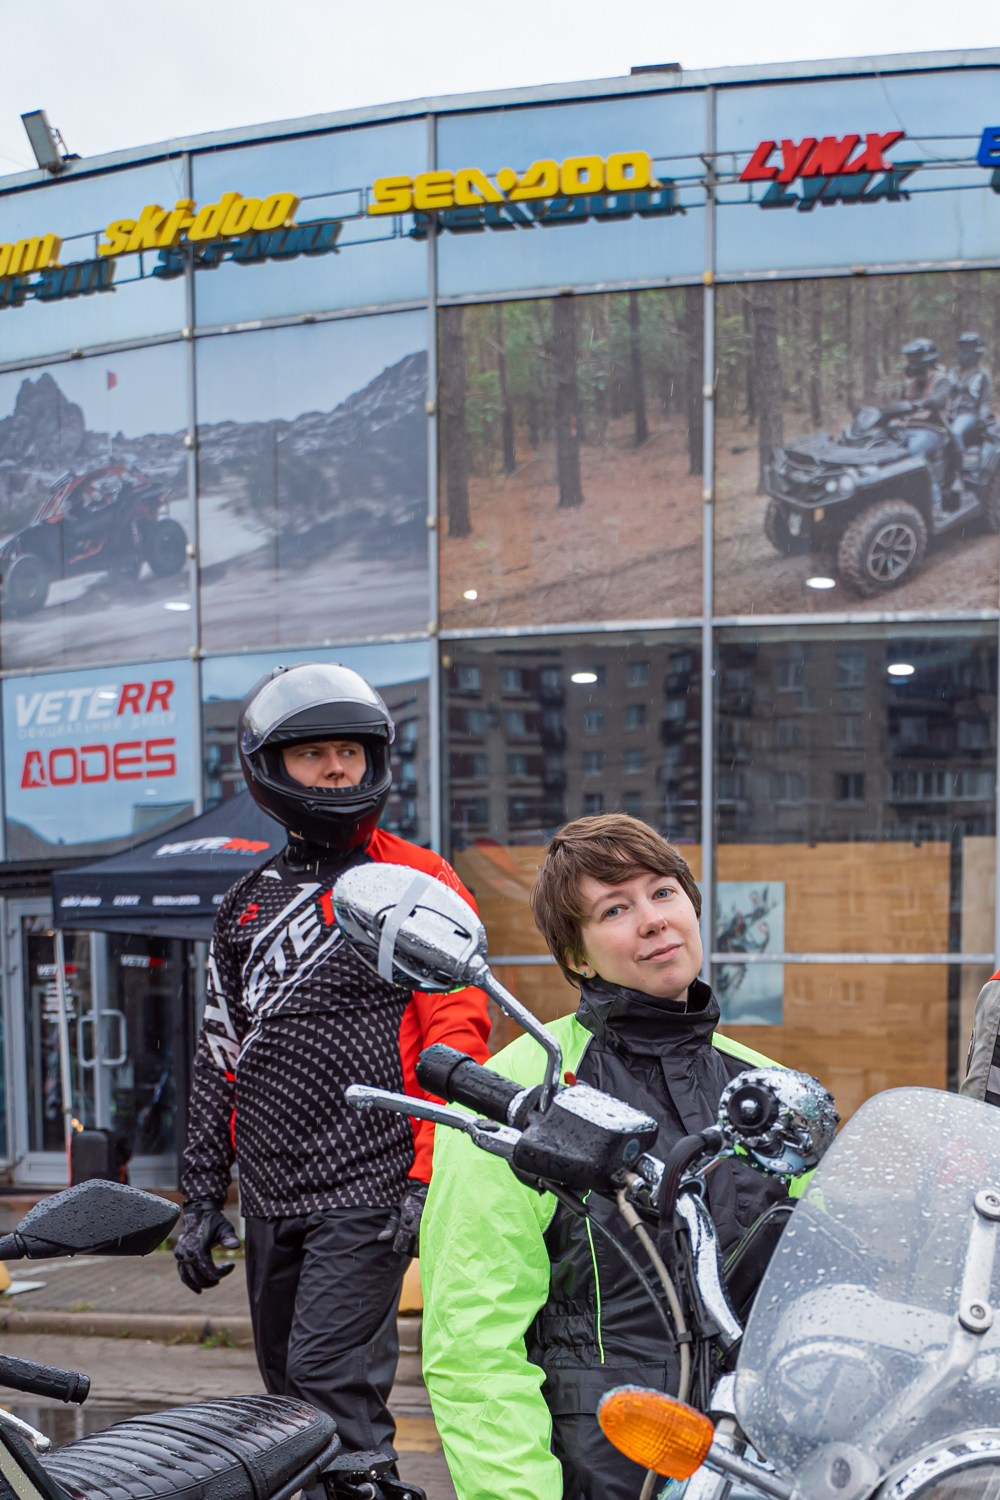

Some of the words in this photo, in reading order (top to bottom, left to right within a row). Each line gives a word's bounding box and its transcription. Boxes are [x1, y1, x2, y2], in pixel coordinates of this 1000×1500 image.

[739, 131, 905, 183] LYNX
[15, 680, 175, 727] VETERR
[21, 737, 176, 789] AODES
